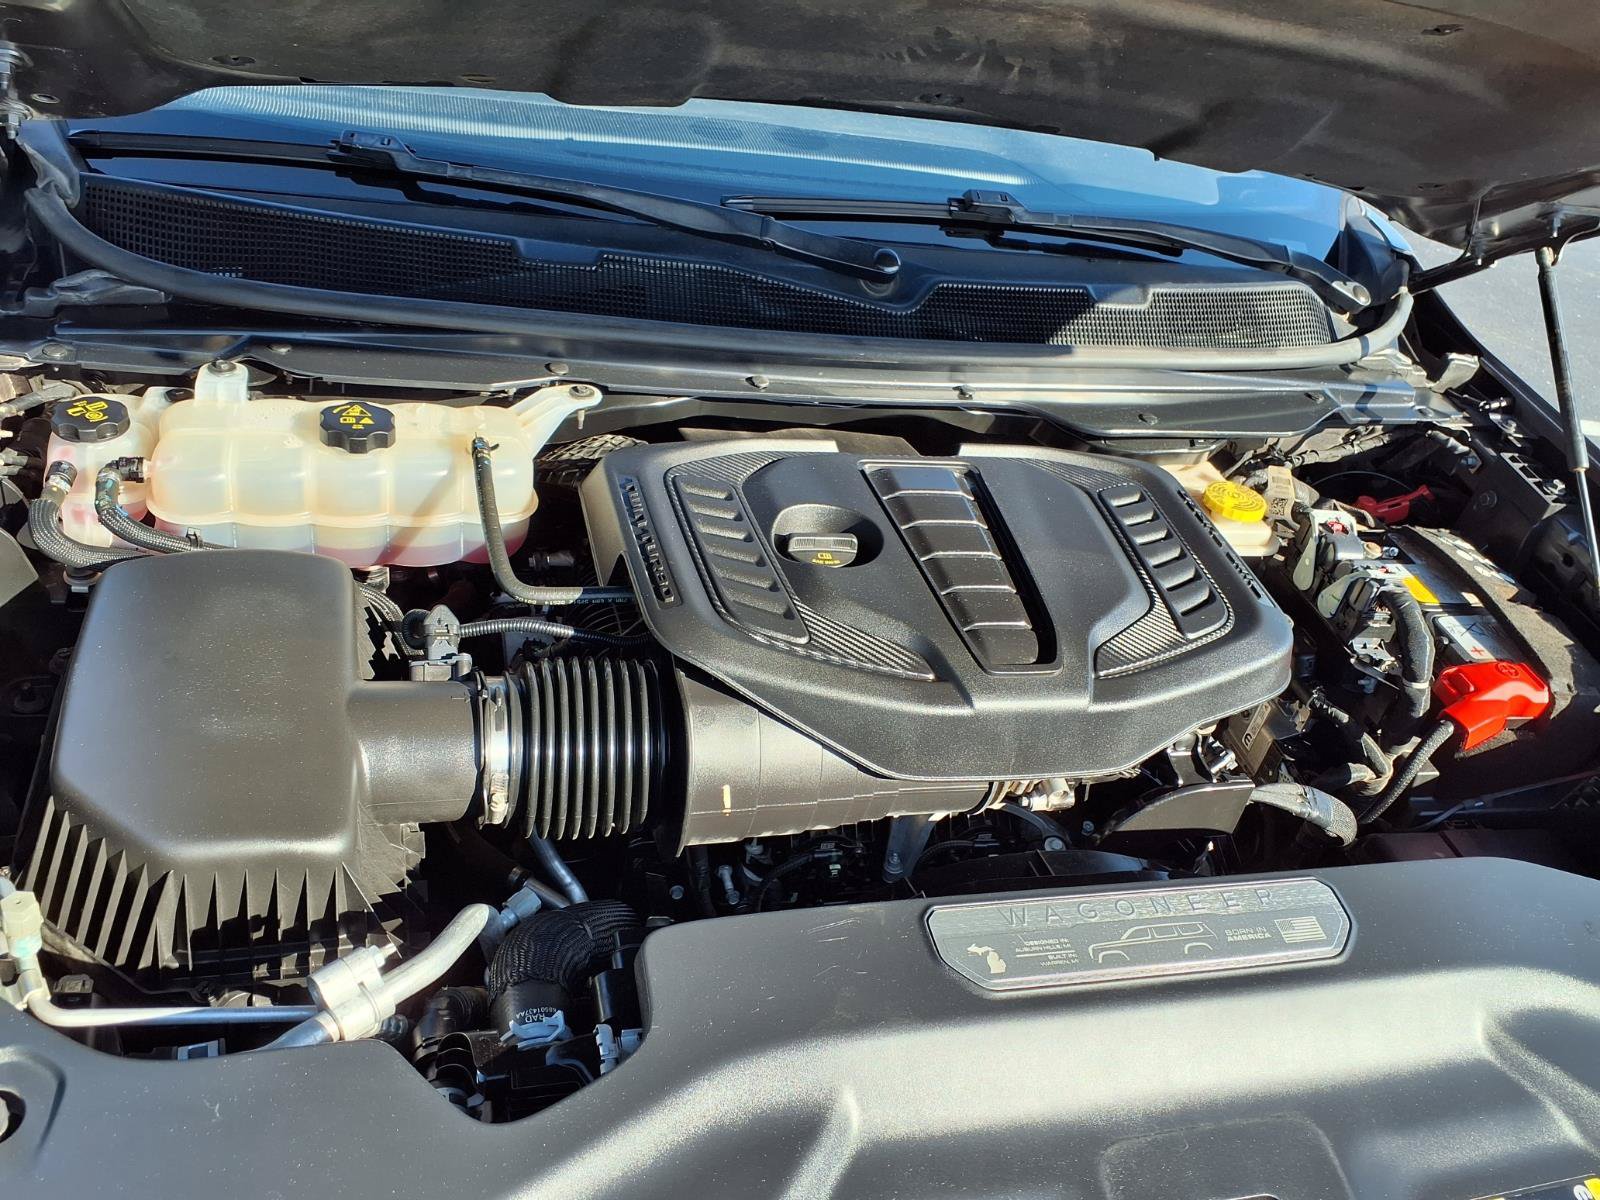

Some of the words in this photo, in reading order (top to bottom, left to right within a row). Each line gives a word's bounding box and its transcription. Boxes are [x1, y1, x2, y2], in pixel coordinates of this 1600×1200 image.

[999, 889, 1274, 926] WAGONEER
[1225, 928, 1254, 936] BORN
[1227, 932, 1272, 942] AMERICA
[525, 1013, 546, 1023] RAD
